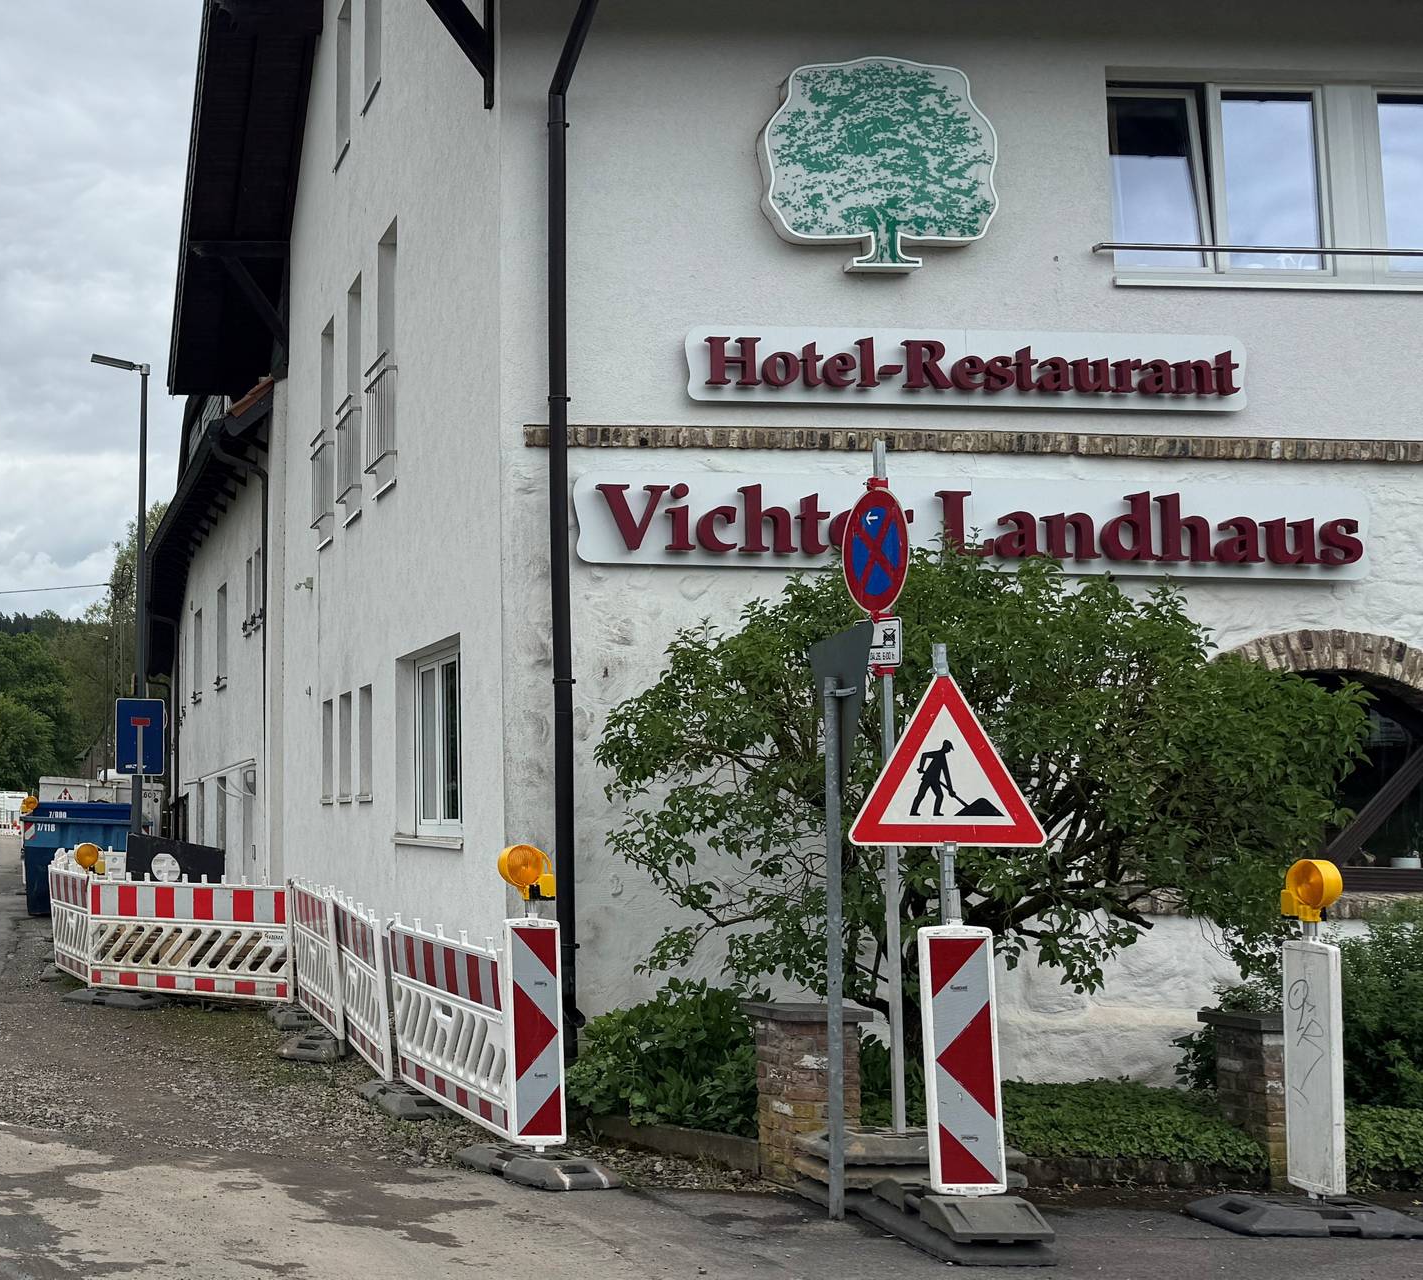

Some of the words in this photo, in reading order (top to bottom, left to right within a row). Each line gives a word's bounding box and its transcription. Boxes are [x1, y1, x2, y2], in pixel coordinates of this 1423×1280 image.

[704, 336, 1241, 396] Hotel-Restaurant
[595, 483, 914, 555] Vicht
[935, 489, 1364, 566] Landhaus
